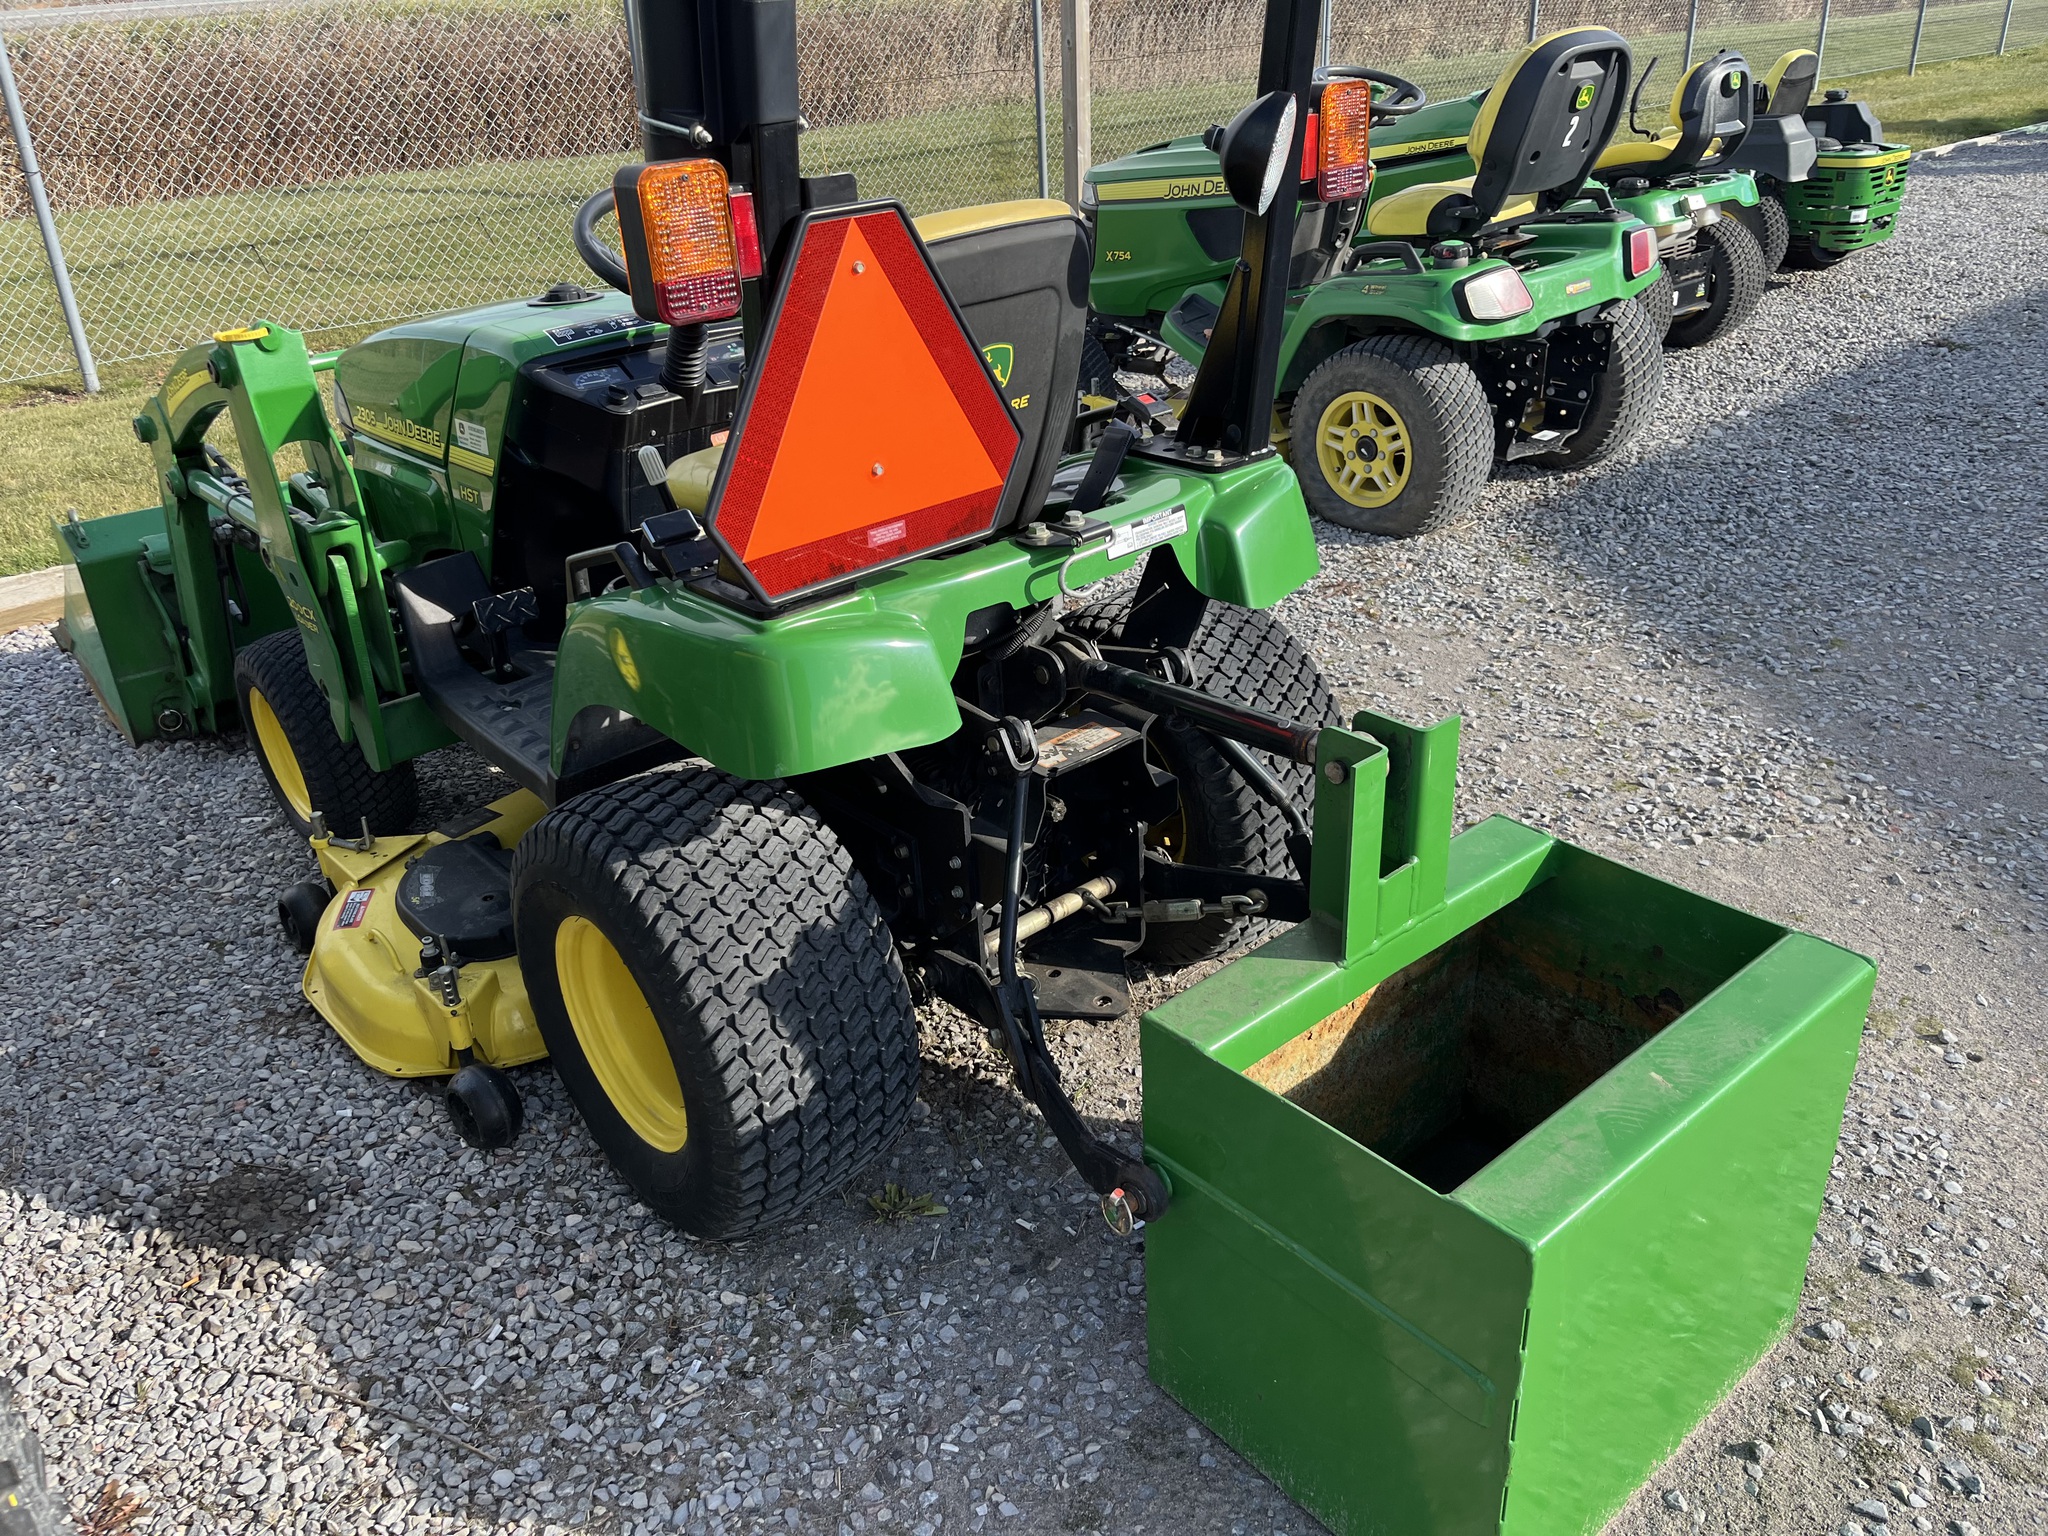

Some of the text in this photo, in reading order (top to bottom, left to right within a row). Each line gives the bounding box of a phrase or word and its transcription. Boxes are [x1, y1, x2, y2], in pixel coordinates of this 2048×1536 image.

[1562, 115, 1580, 147] 2
[1405, 139, 1455, 154] JOHN DEERE
[1164, 183, 1201, 199] JOHN
[1105, 250, 1131, 261] X754
[356, 405, 377, 427] 2305
[383, 411, 408, 437] JOHN
[406, 418, 442, 447] DEERE
[460, 485, 479, 505] HST
[1142, 508, 1173, 525] IMPORTANT
